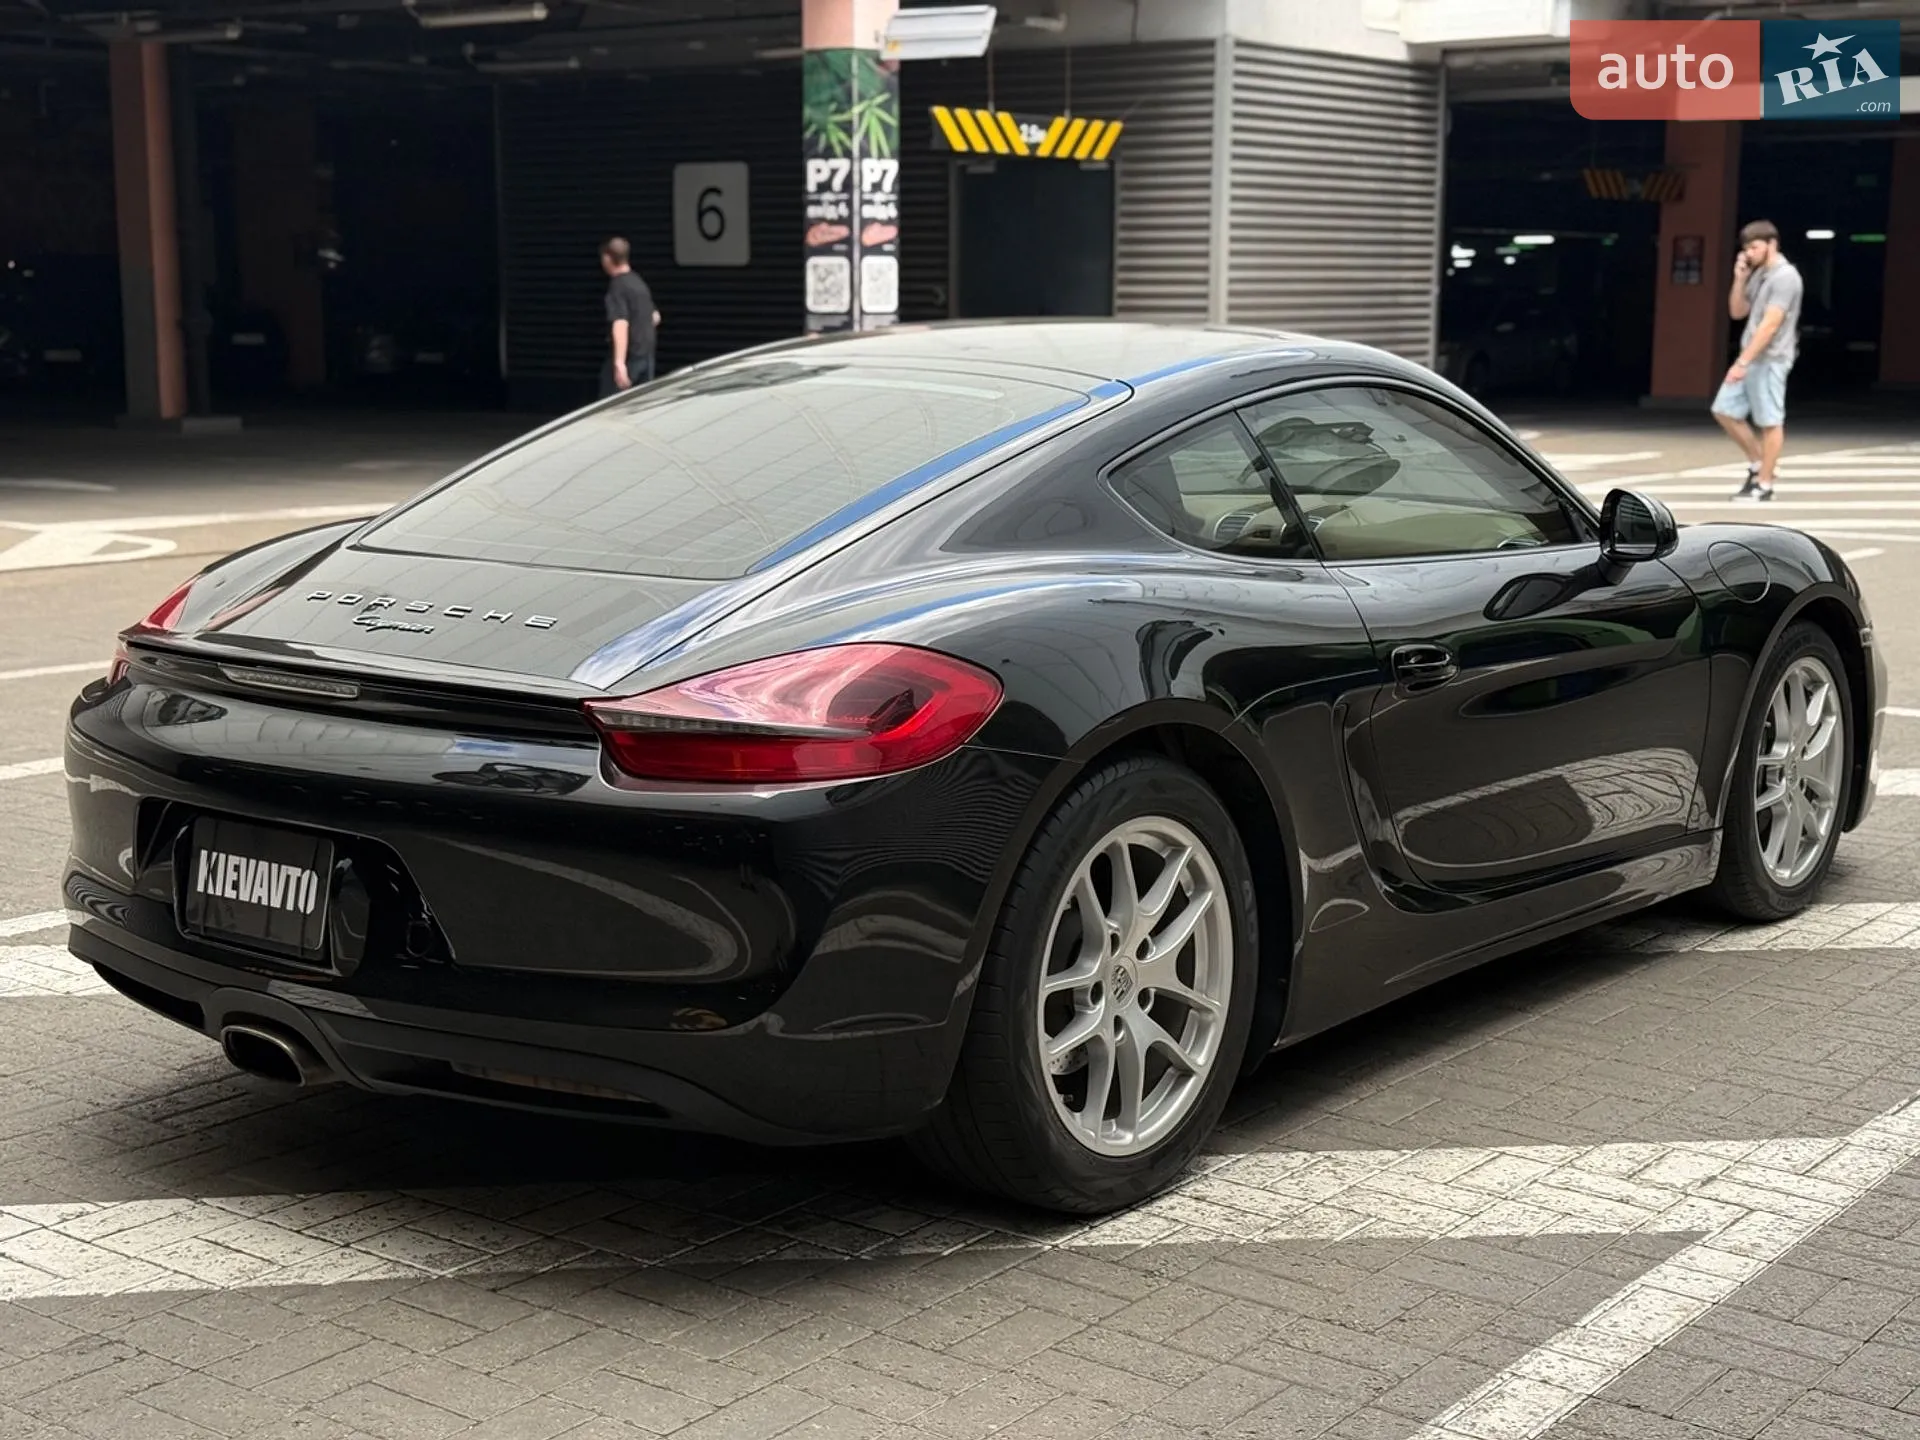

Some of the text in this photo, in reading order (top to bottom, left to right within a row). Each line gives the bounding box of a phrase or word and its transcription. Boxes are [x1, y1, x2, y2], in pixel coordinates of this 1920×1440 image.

[806, 158, 851, 193] P7
[861, 158, 899, 193] P7
[697, 187, 725, 241] 6
[306, 590, 559, 630] PORSCHE
[352, 613, 435, 635] Cayman
[197, 849, 319, 915] KIEVAVTO
